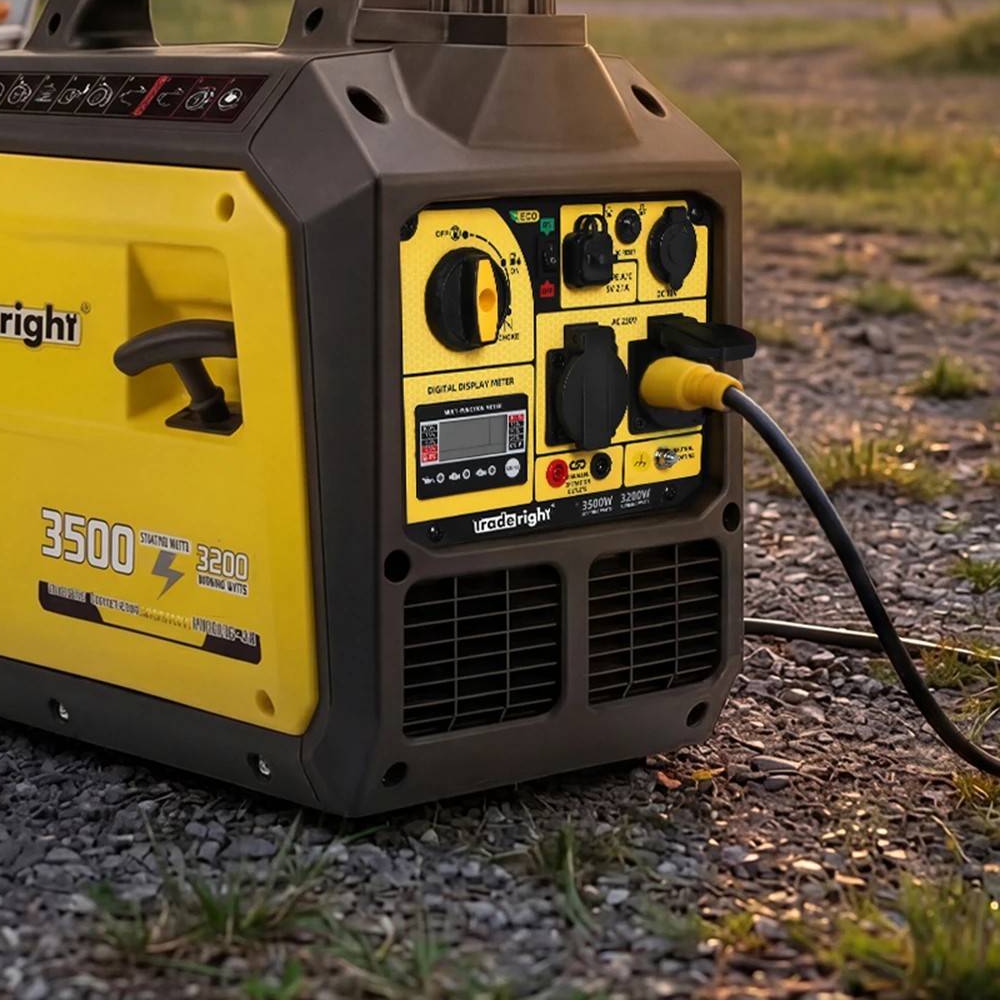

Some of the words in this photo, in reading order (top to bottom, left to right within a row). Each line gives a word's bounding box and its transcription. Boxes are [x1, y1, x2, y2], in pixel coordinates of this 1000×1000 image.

[520, 212, 538, 221] ECO
[427, 384, 457, 395] DIGITAL
[458, 380, 489, 391] DISPLAY
[491, 377, 514, 387] METER
[582, 496, 613, 511] 3500W
[621, 488, 650, 503] 3200W
[473, 507, 551, 534] Traderight
[41, 507, 134, 576] 3500
[196, 544, 249, 582] 3200
